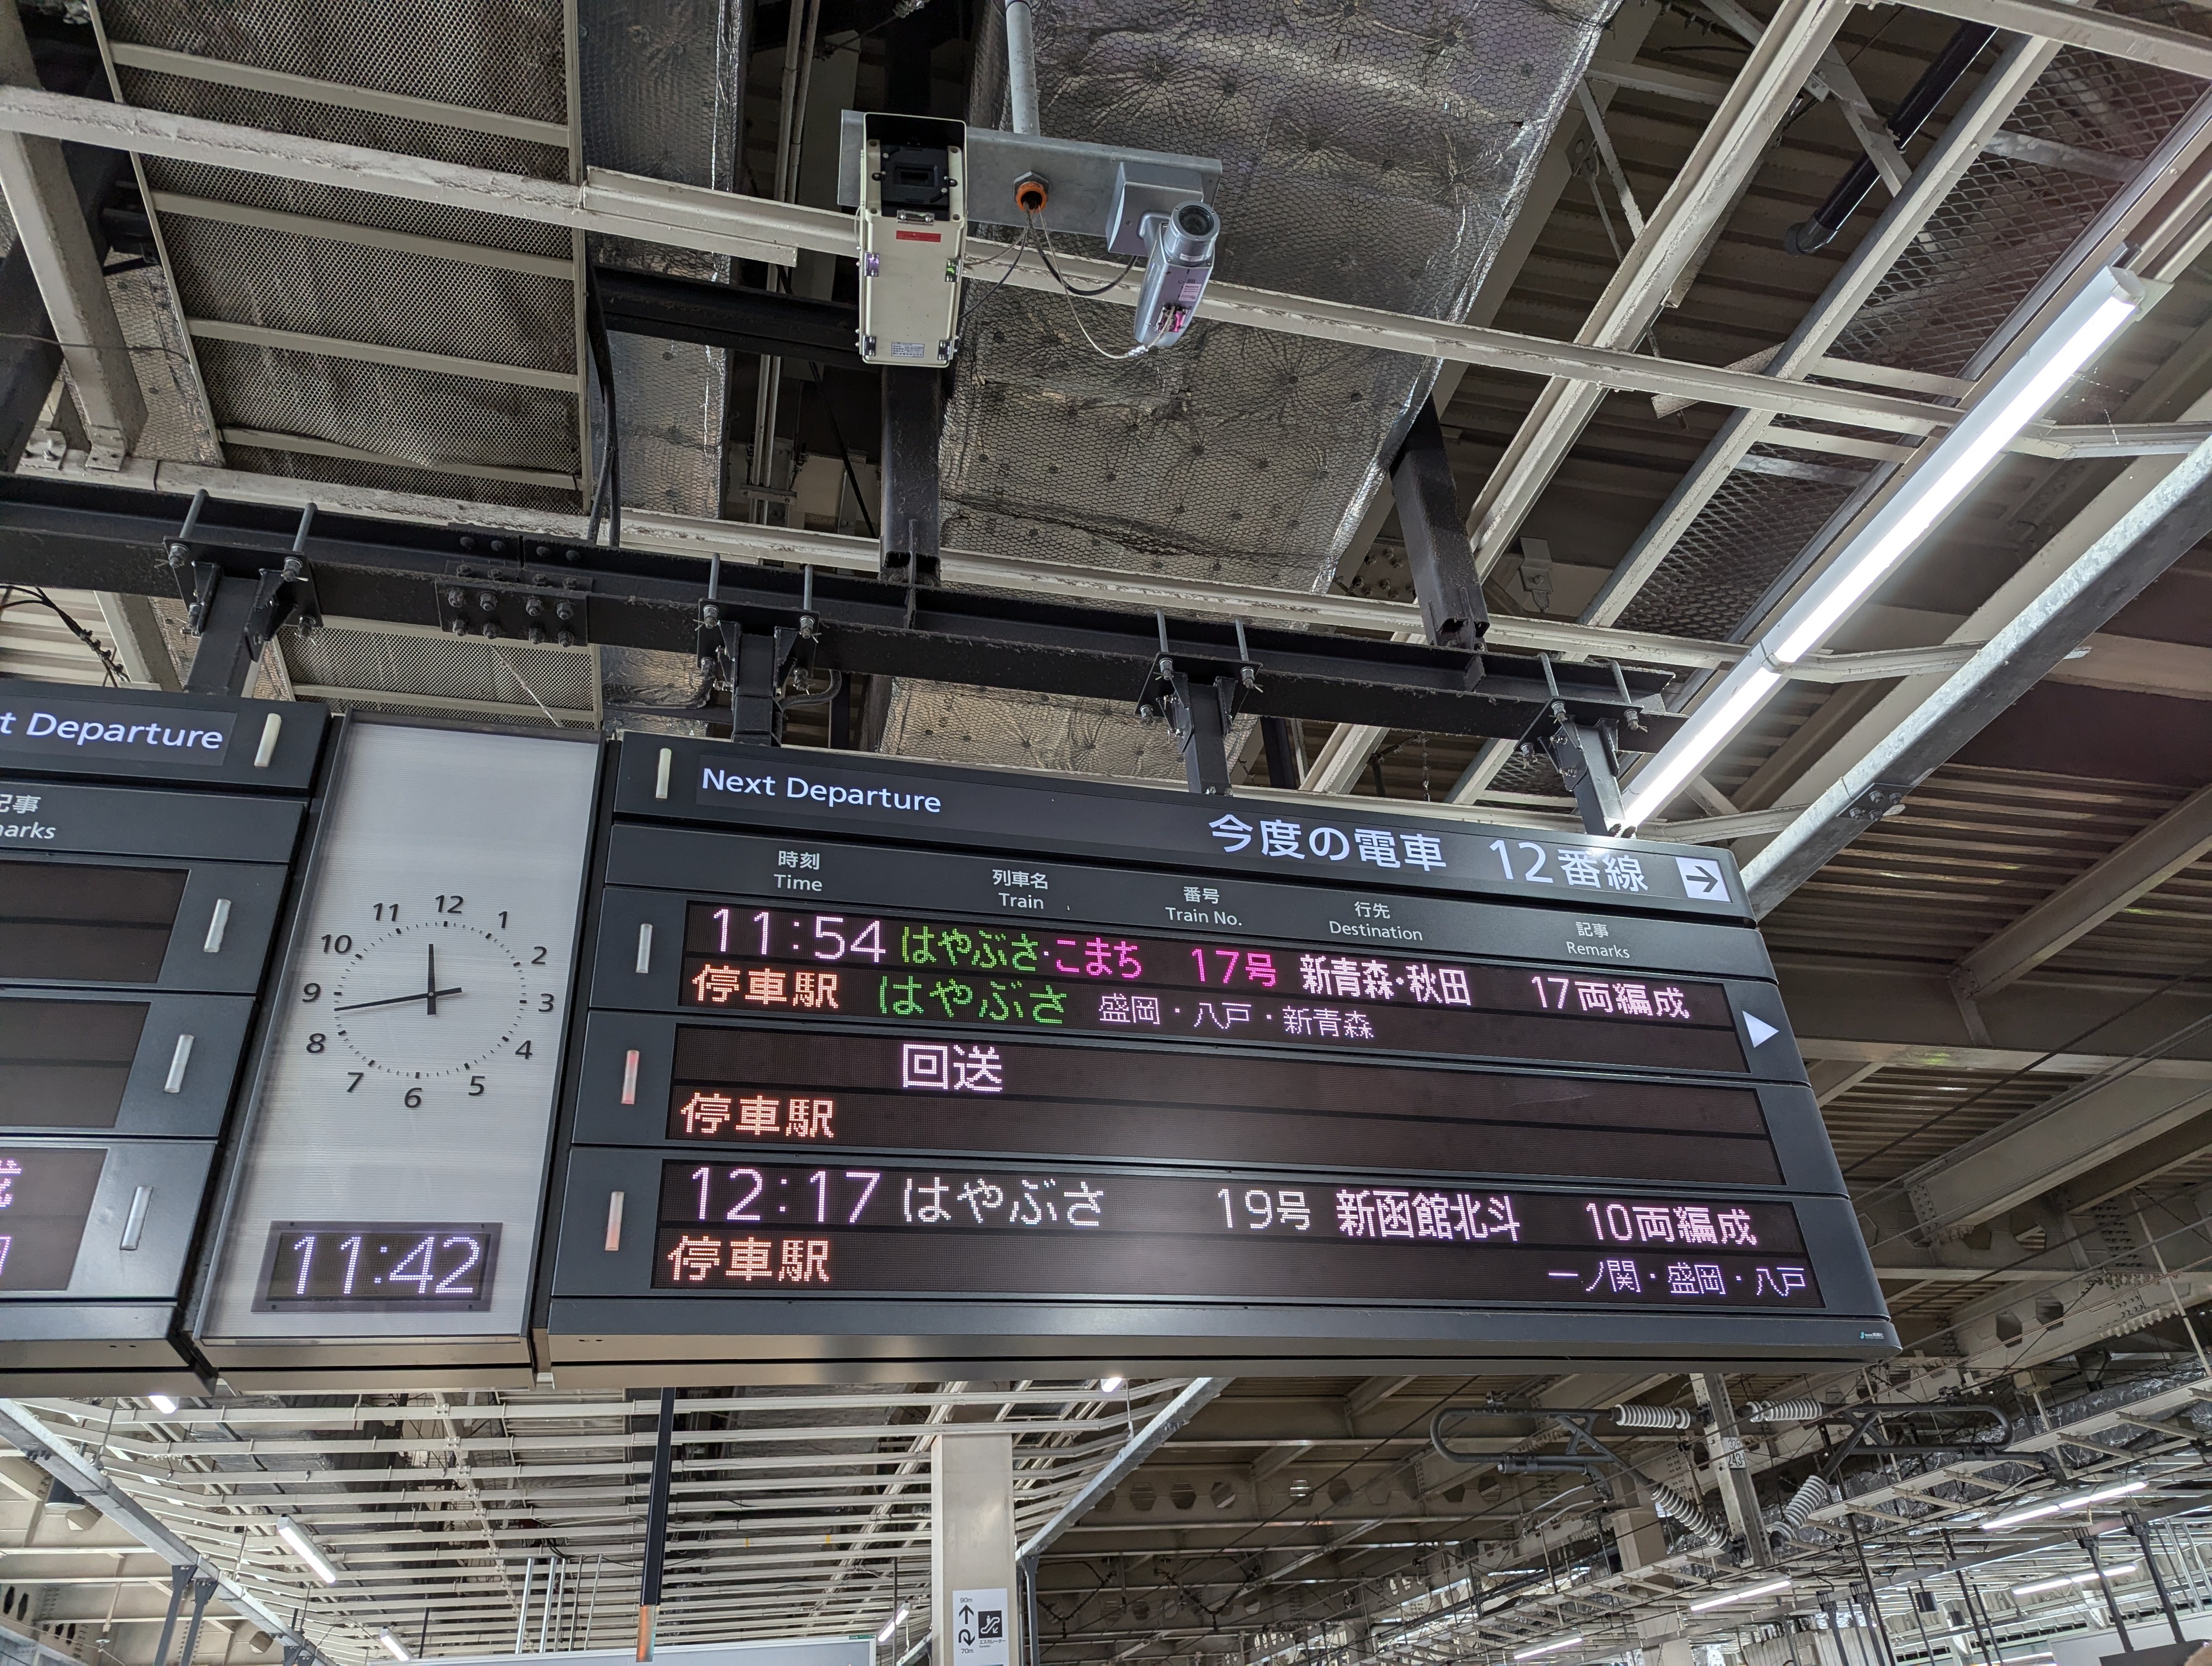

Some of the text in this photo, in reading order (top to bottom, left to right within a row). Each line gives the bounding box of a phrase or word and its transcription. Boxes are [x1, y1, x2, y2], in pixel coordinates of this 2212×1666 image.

[27, 713, 222, 748] Departure
[703, 768, 941, 812] Next Departure
[779, 851, 819, 870] 時刻
[1209, 813, 1649, 892] 今度の電車 12番線
[774, 874, 822, 891] Time
[993, 869, 1047, 889] 列車名
[435, 895, 464, 914] 12
[999, 893, 1043, 909] Train
[1184, 887, 1219, 904] 番号
[373, 903, 399, 922] 11
[498, 911, 509, 929] 1
[1165, 907, 1242, 926] Train No.
[1354, 901, 1390, 919] 行先
[1329, 921, 1423, 940] Destination
[1576, 921, 1609, 938] 記事
[321, 934, 352, 954] 10
[1566, 941, 1630, 959] Remarks
[531, 946, 547, 965] 2
[714, 909, 885, 962] 11:54
[1192, 949, 1276, 986] 17号
[1531, 976, 1690, 1019] 17両編成
[301, 983, 321, 1003] 9
[692, 964, 838, 1008] 停車駅
[880, 976, 1066, 1023] はやぶさ
[538, 994, 554, 1013] 3
[306, 1033, 326, 1054] 8
[515, 1040, 532, 1060] 4
[903, 1044, 1002, 1092] 回送
[346, 1072, 364, 1093] 7
[468, 1076, 486, 1096] 5
[404, 1087, 422, 1108] 6
[681, 1093, 834, 1138] 停車駅
[693, 1168, 1757, 1245] 12:17 はやぶさ 19号 新函館北斗 10両編成
[294, 1236, 479, 1294] 11:42
[668, 1235, 829, 1281] 停車駅
